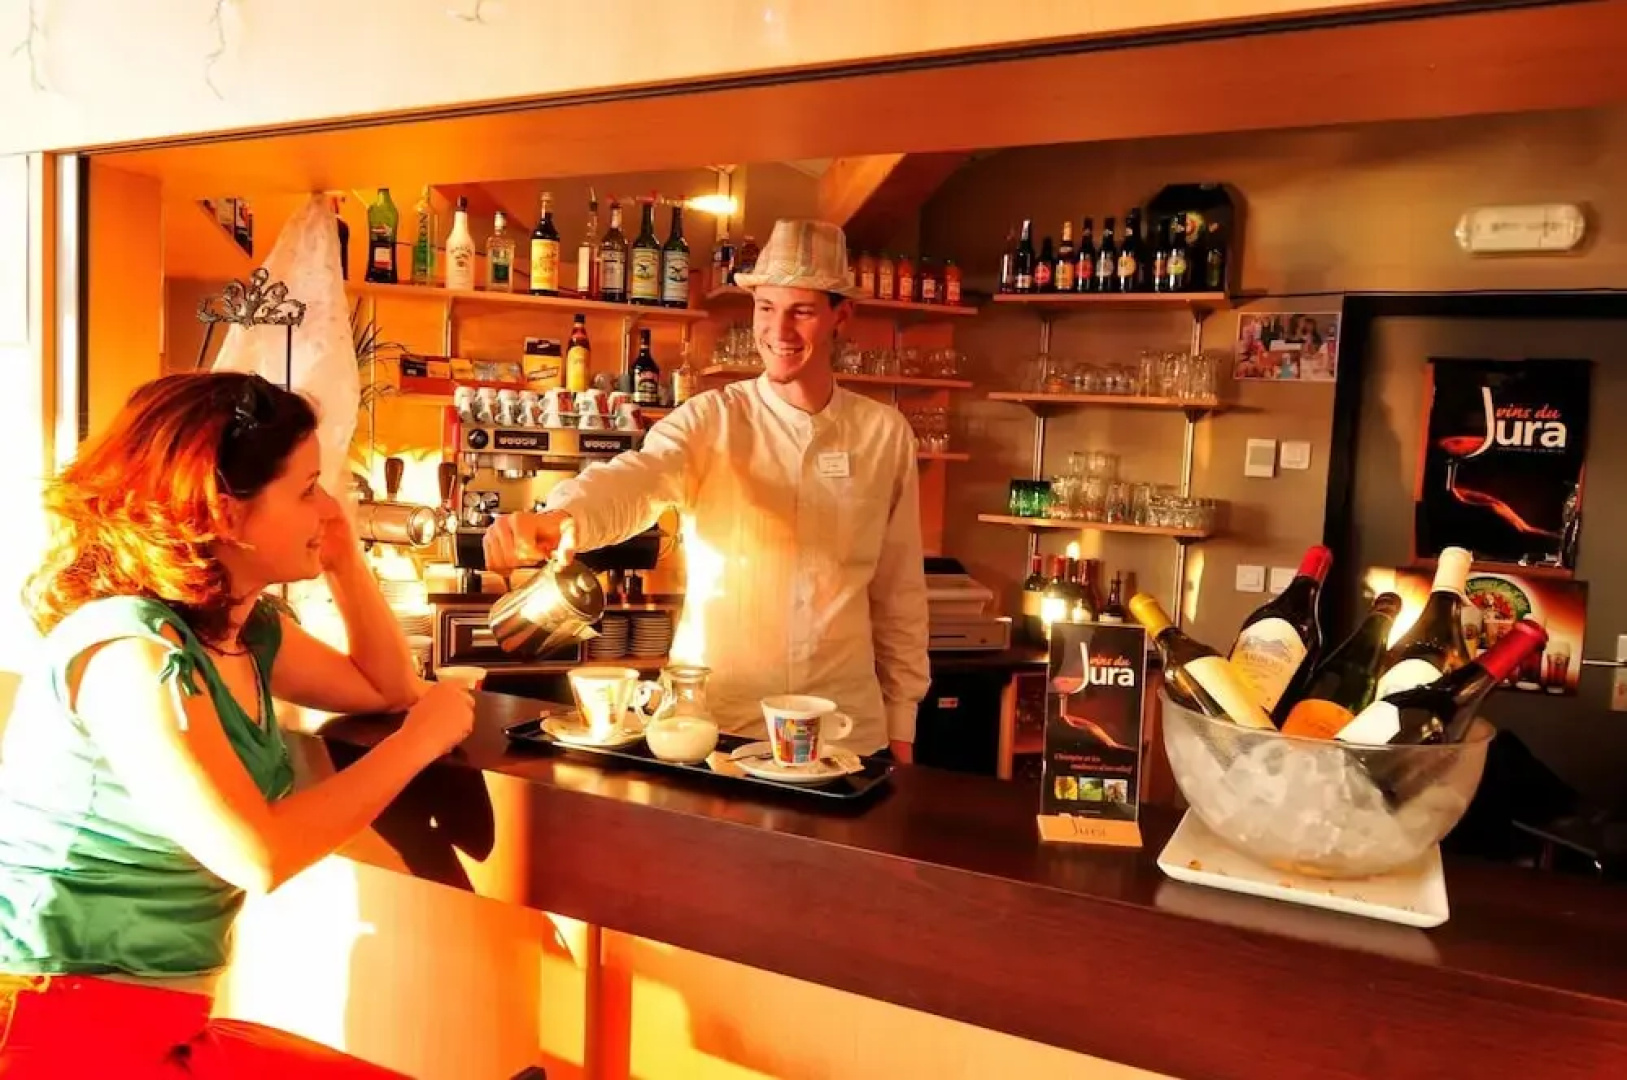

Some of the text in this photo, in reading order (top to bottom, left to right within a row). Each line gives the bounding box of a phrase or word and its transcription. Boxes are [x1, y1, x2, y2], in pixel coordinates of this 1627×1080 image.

[1465, 386, 1567, 458] Jura
[1496, 403, 1560, 418] vins du
[1070, 641, 1135, 693] Jura
